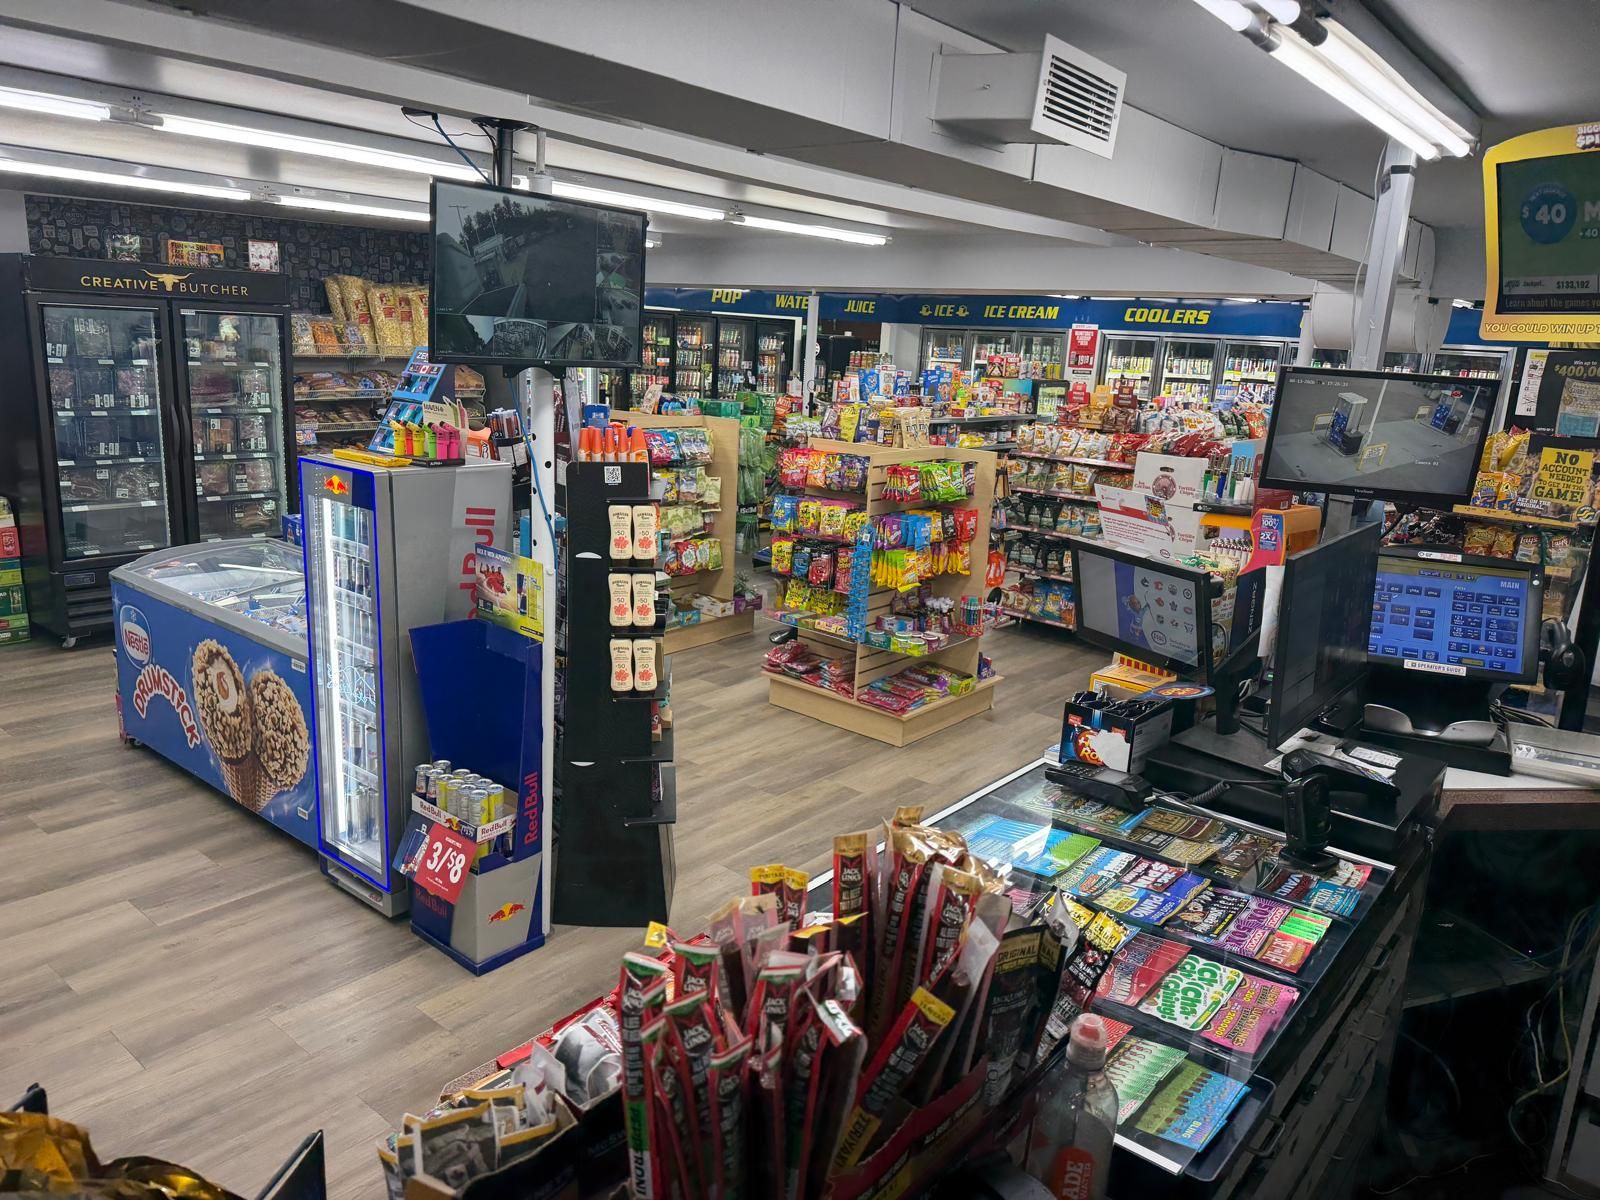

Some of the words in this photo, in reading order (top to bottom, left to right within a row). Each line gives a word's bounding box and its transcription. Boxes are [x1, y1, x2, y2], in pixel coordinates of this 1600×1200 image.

[1535, 204, 1566, 225] 40
[80, 275, 158, 291] CREATIVE
[179, 282, 249, 296] BUTCHER
[711, 289, 742, 304] POP
[775, 294, 809, 309] WATE
[844, 299, 876, 314] JUICE
[934, 305, 955, 316] ICE
[983, 305, 1007, 318] ICE
[1008, 306, 1060, 320] CREAM
[1124, 308, 1211, 325] COOLERS
[1484, 323, 1508, 333] YOU
[1509, 323, 1548, 333] COULD
[1550, 324, 1576, 334] WIN
[1576, 324, 1595, 334] UP
[1555, 452, 1579, 466] NO
[1541, 464, 1589, 476] ACCOUNT
[1549, 473, 1583, 484] NEEDED
[1535, 486, 1585, 503] GAME!
[1500, 581, 1520, 590] MAIN
[133, 664, 200, 749] DRUMSTICK
[524, 772, 538, 808] Bull
[481, 824, 494, 835] Red
[524, 810, 538, 845] Red
[1130, 860, 1169, 889] SPIN
[1248, 902, 1273, 925] 50X
[1226, 922, 1250, 947] 50X
[999, 945, 1036, 960] ORIGINAL
[686, 975, 706, 985] JACK
[766, 998, 784, 1006] JACK
[683, 1023, 706, 1037] JACK
[1182, 1119, 1202, 1139] BLING
[630, 1107, 648, 1197] PEPPERONI
